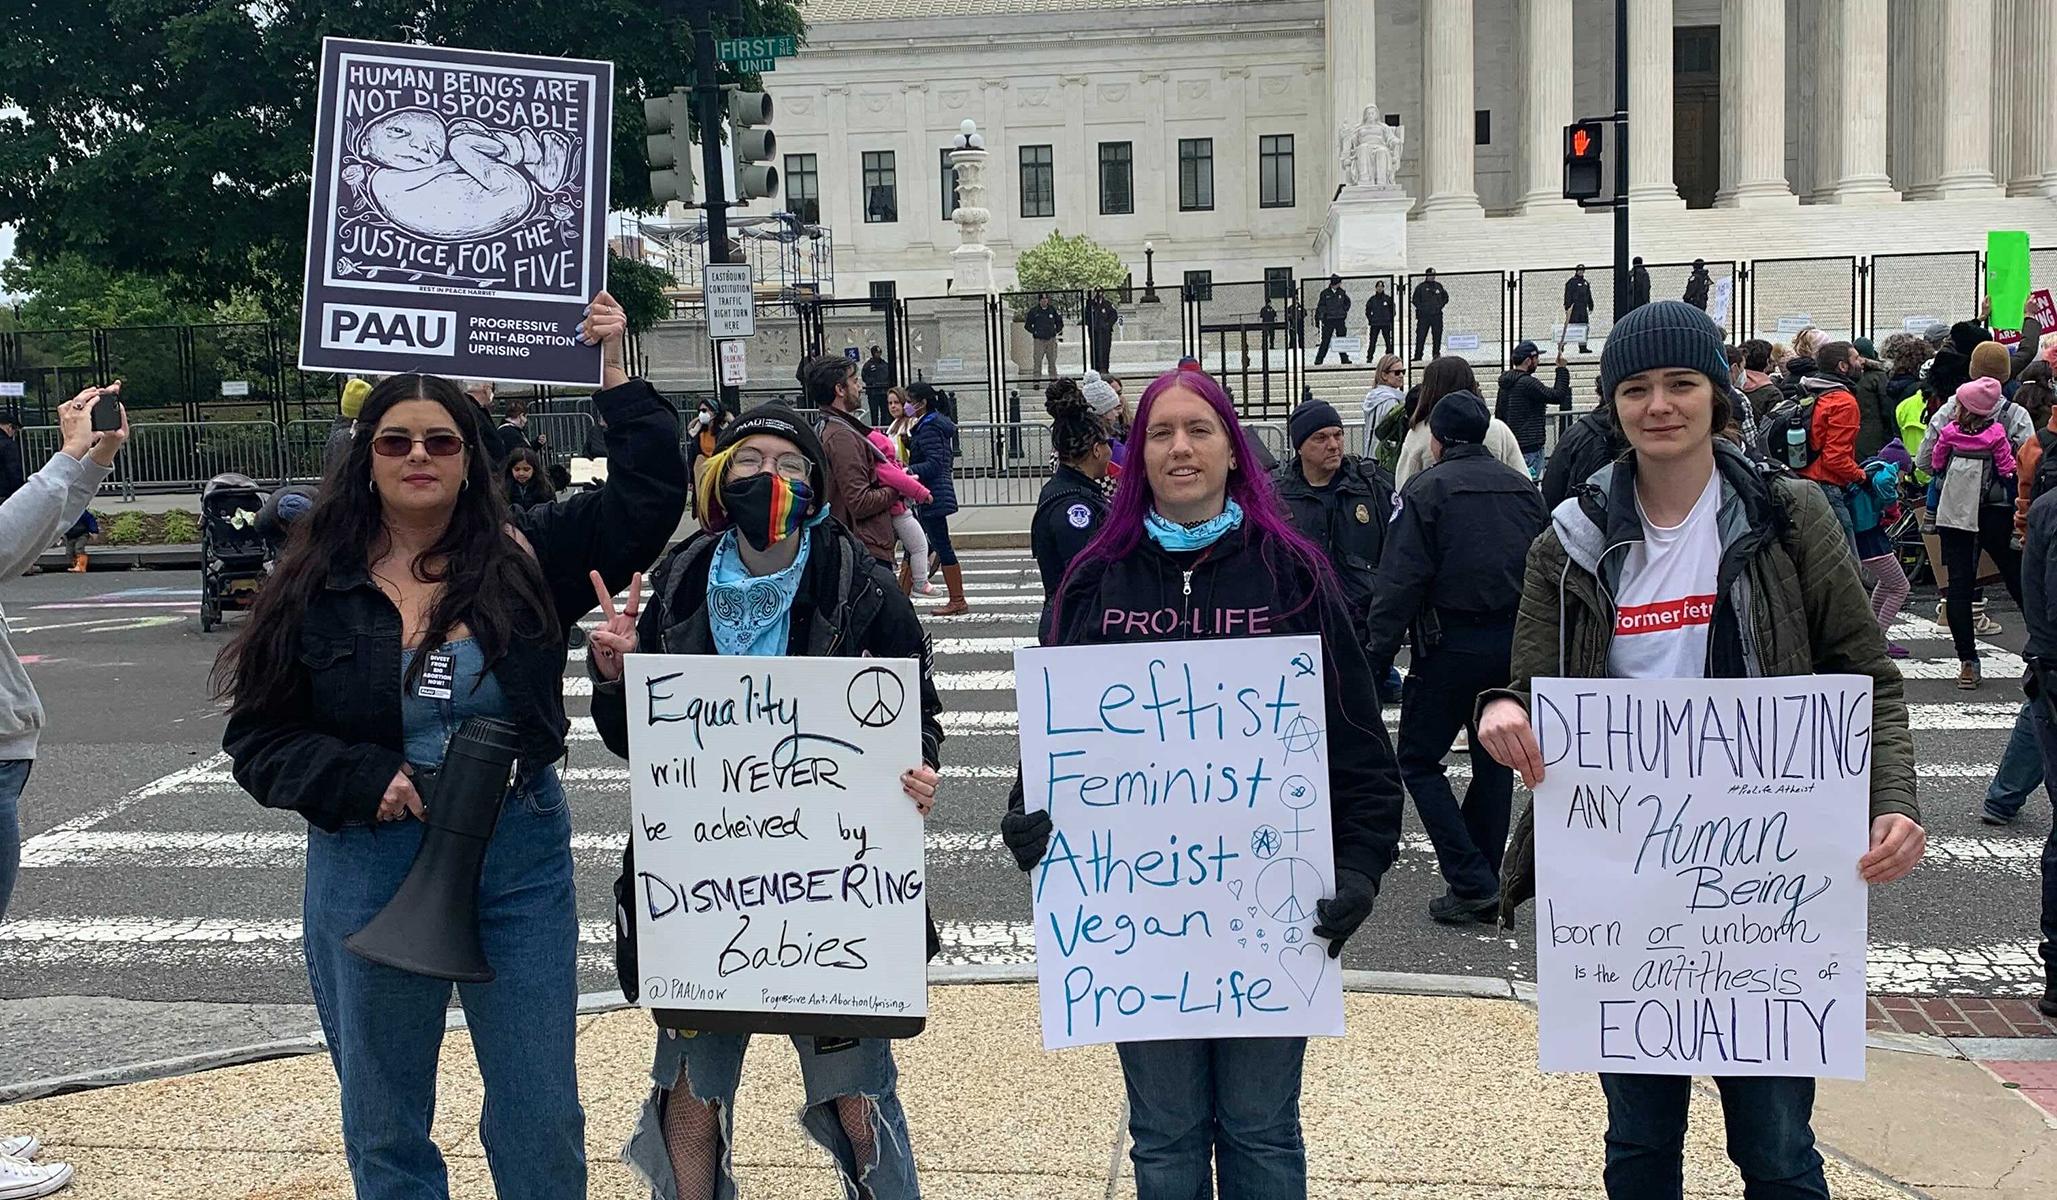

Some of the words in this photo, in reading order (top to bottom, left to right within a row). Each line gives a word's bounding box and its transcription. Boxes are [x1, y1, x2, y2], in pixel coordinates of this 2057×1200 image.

[721, 39, 775, 59] FIRST
[779, 38, 790, 46] ST
[740, 59, 772, 72] UNIT
[779, 47, 792, 55] NE
[350, 66, 434, 91] HUMAN
[444, 72, 526, 99] BEINGS
[534, 80, 579, 103] ARE
[346, 88, 402, 117] NOT
[415, 89, 579, 132] DISPOSABLE
[340, 225, 449, 266] JUSTICE
[458, 241, 507, 273] FOR
[512, 221, 553, 251] THE
[514, 249, 576, 289] FIVE
[712, 272, 746, 281] EASTBOUND
[468, 288, 496, 296] HARRIET
[709, 285, 750, 294] CONSTITUTION
[718, 297, 742, 306] TRAFFIC
[329, 309, 447, 349] PAAU
[469, 317, 558, 332] PROGRESSIVE
[714, 309, 731, 318] RIGHT
[733, 308, 748, 317] TURN
[724, 321, 740, 330] HERE
[468, 344, 530, 357] UPRISING
[469, 330, 575, 347] ANTI-ABORTION
[729, 345, 738, 354] NO
[1616, 609, 1681, 629] former
[646, 672, 864, 768] Equality
[1044, 658, 1300, 743] Leftist
[1537, 690, 1870, 780] DEHUMANIZING
[651, 756, 697, 789] will
[722, 755, 847, 793] NEVER
[1048, 750, 1272, 818] Feminist
[641, 812, 672, 841] be
[693, 808, 809, 843] acheived
[838, 811, 882, 861] by
[1567, 783, 1631, 834] ANY
[1634, 793, 1798, 874] Human
[1037, 828, 1239, 904] Atheist
[638, 863, 923, 921] DISMEMBERING
[1676, 865, 1832, 928] Being
[1050, 905, 1212, 958] Vegan
[1548, 899, 1622, 948] born
[1647, 923, 1683, 945] or
[1701, 914, 1821, 945] unborn
[644, 976, 728, 1000] @PAAUnow
[1575, 965, 1587, 980] is
[1593, 963, 1620, 984] the
[1632, 951, 1802, 996] antithesis
[1818, 961, 1841, 981] of
[761, 988, 806, 1010] Progressive
[808, 993, 828, 1005] Anti
[829, 993, 868, 1007] Abortion
[869, 995, 912, 1012] Uprising
[1064, 966, 1289, 1037] Pro-Life
[1600, 998, 1837, 1066] EQUALITY
